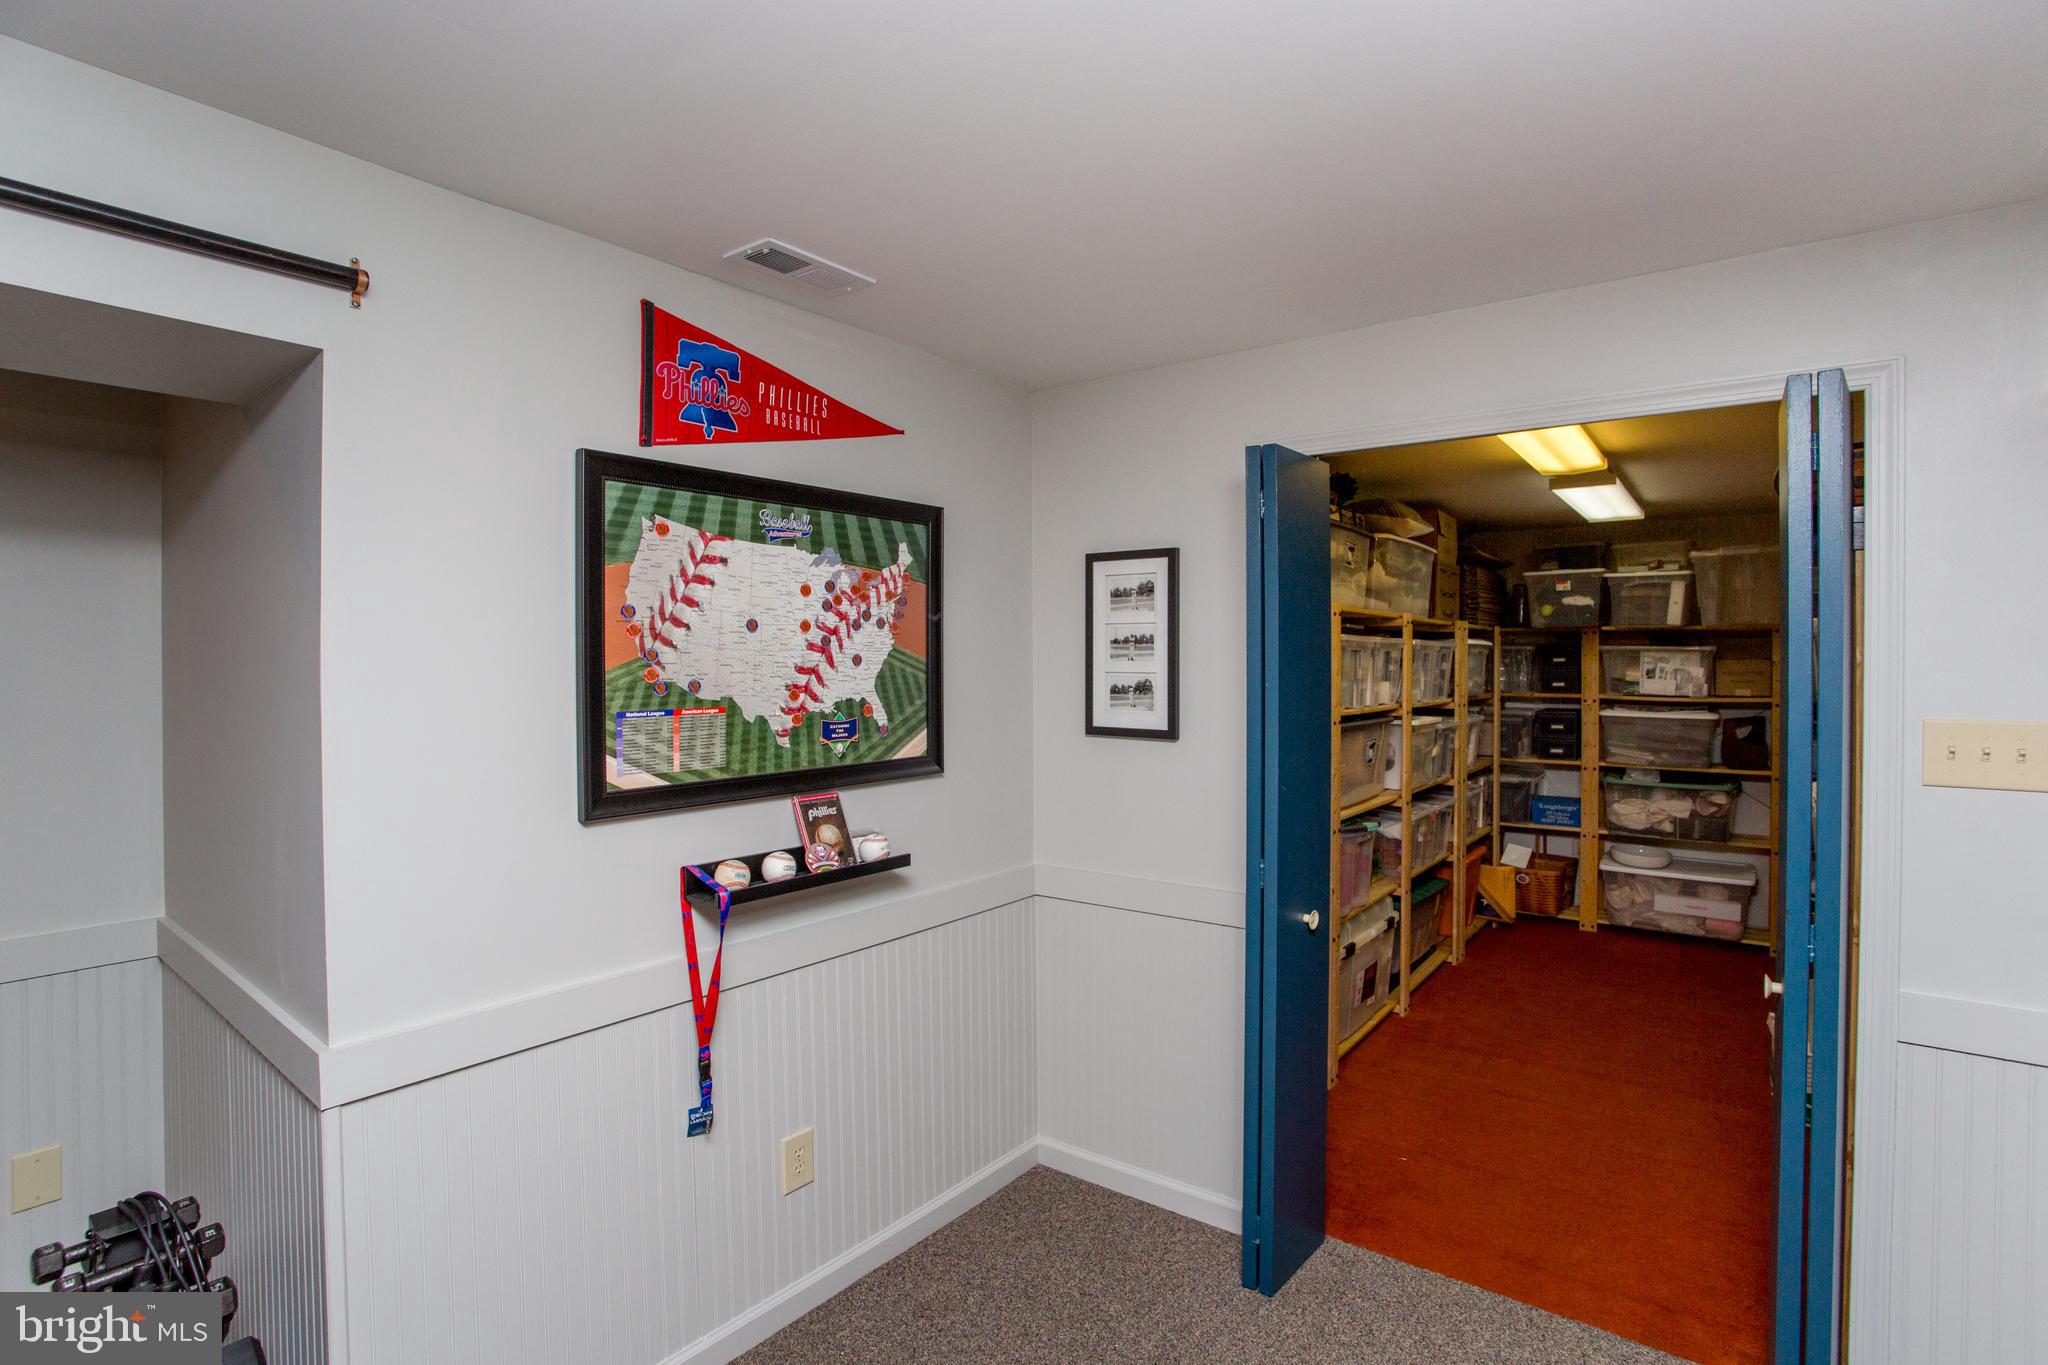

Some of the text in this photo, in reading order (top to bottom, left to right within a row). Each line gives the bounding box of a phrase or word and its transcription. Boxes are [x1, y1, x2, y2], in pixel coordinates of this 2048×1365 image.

[656, 361, 751, 417] Phillies
[758, 381, 829, 418] PHILLIES
[765, 407, 822, 436] BASEBALL
[759, 508, 813, 532] Baseball
